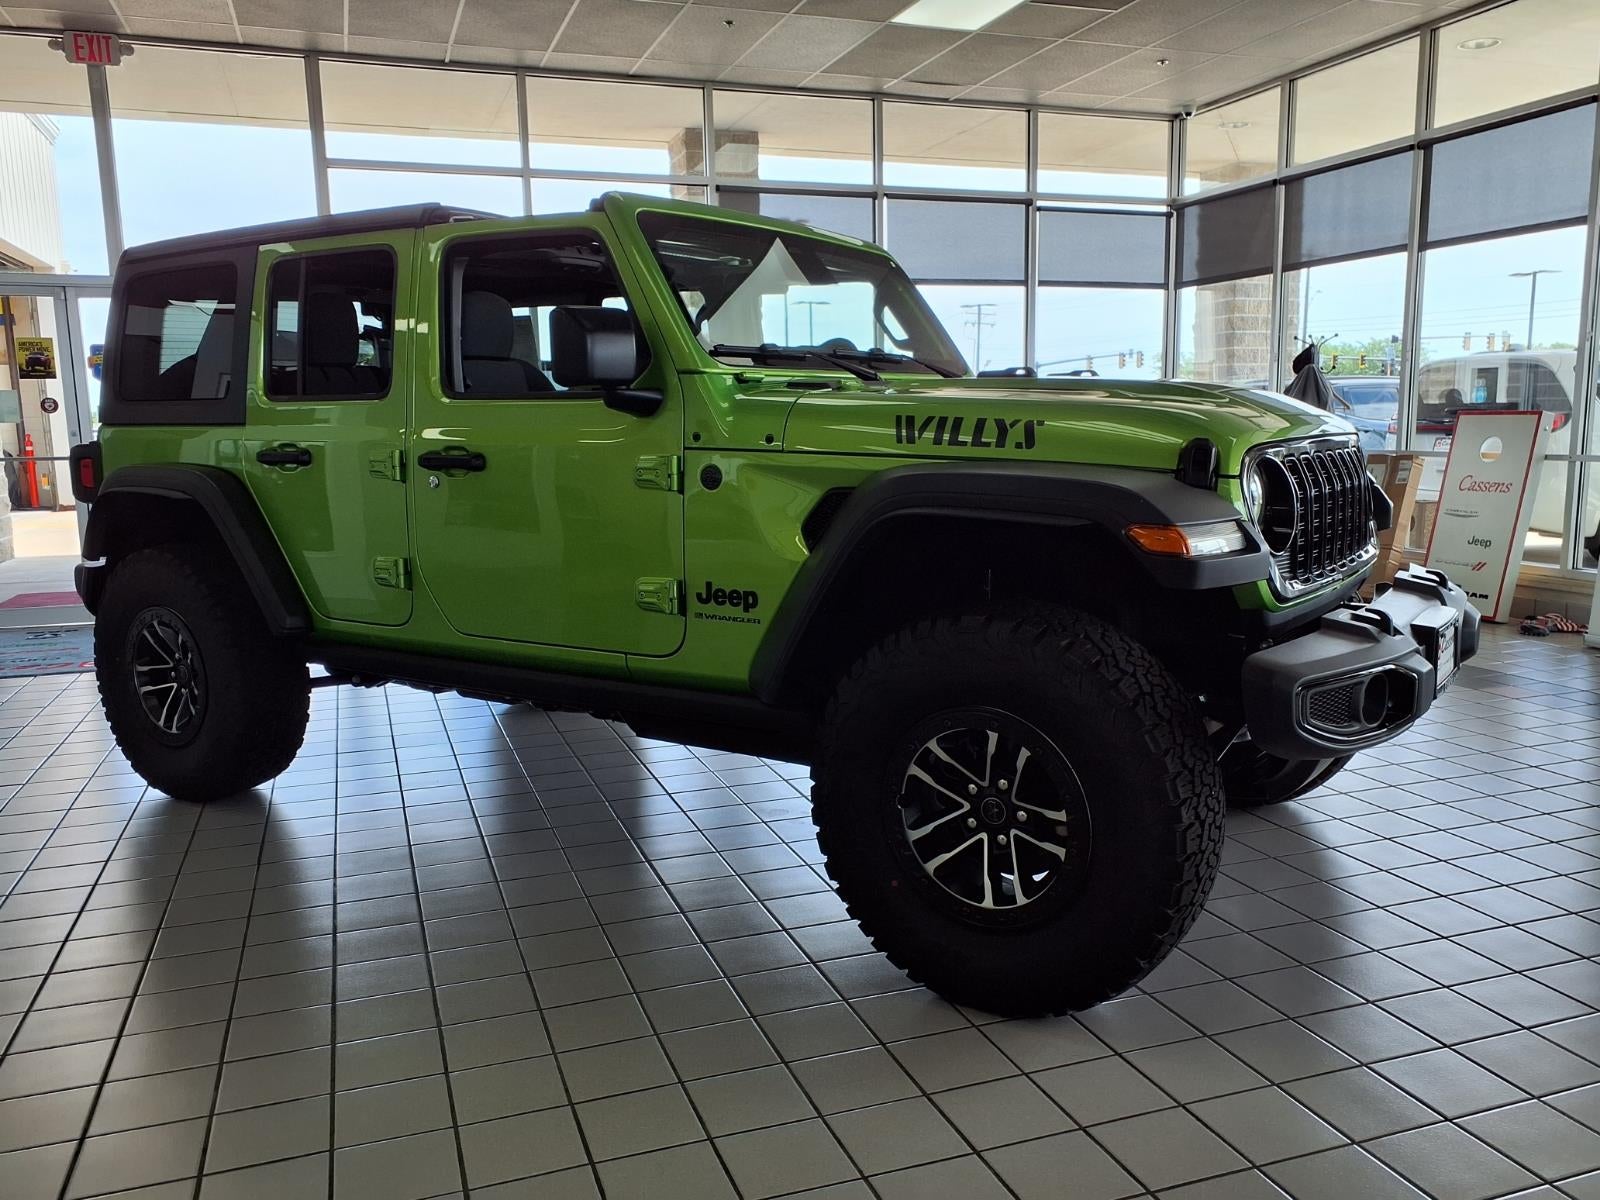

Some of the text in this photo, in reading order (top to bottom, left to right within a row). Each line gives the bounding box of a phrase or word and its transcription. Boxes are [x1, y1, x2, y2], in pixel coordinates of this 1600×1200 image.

[72, 33, 112, 63] EXIT
[895, 415, 1046, 450] WILLYS
[1458, 474, 1513, 494] Cassens
[1467, 536, 1493, 549] Jeep
[695, 581, 759, 613] Jeep
[704, 613, 761, 625] WRANGLER
